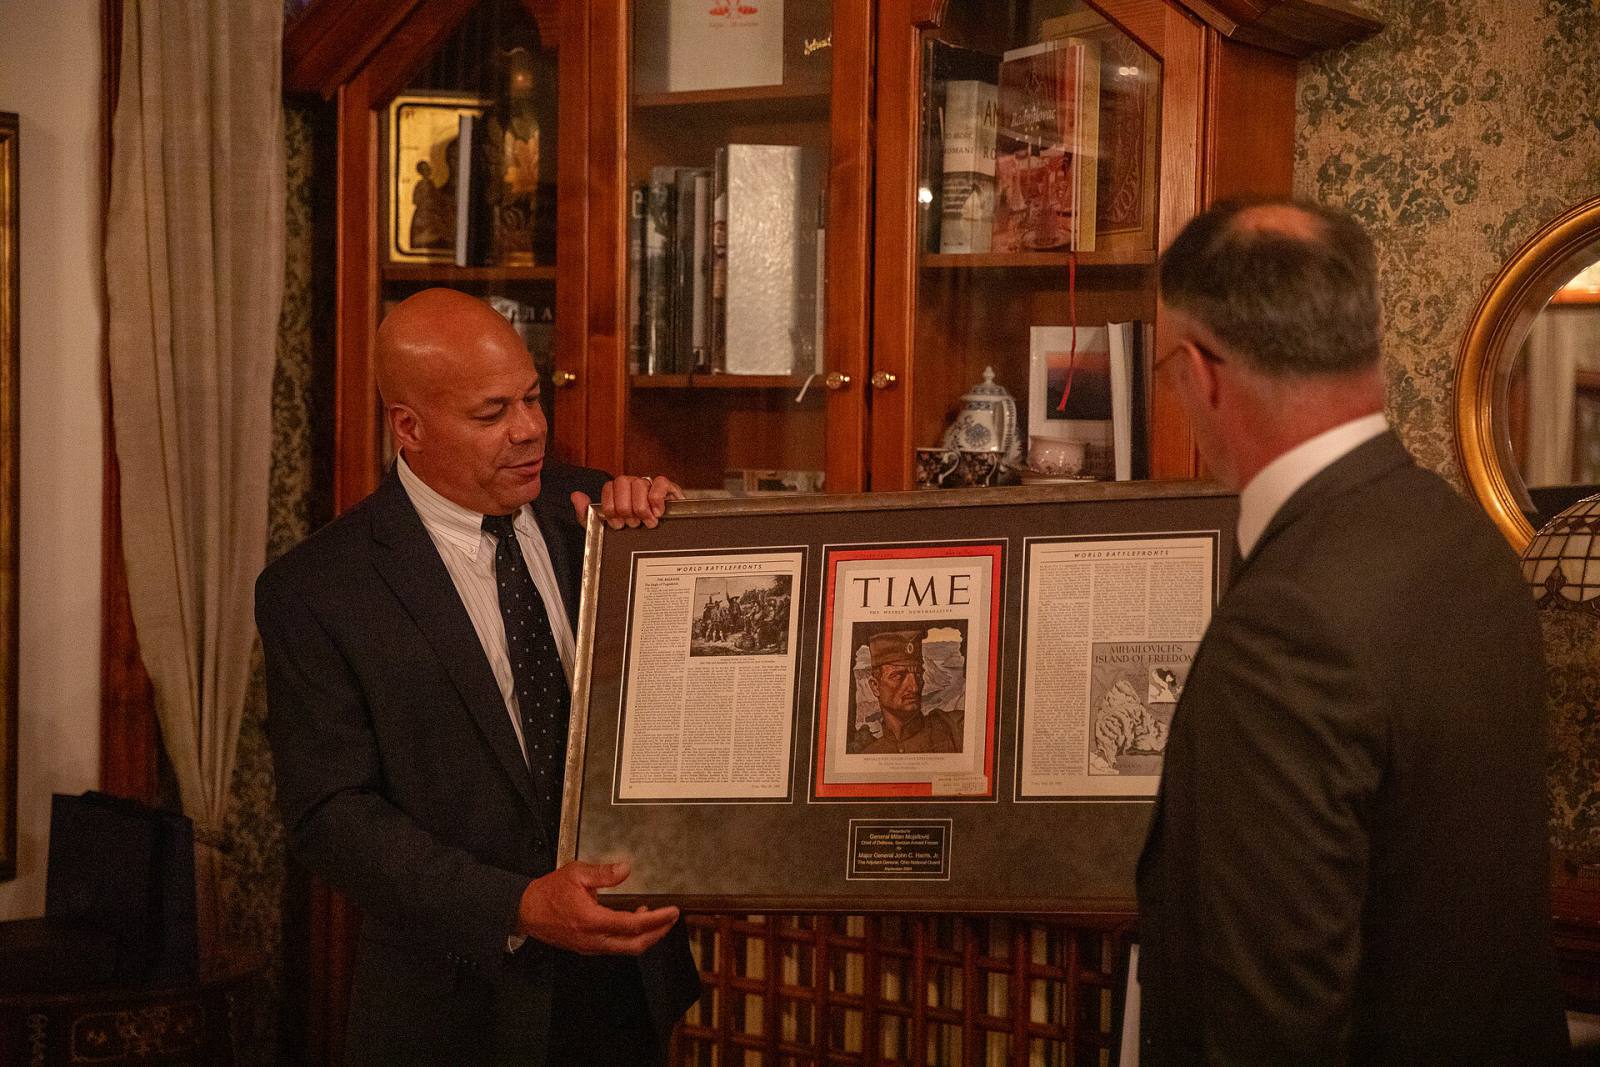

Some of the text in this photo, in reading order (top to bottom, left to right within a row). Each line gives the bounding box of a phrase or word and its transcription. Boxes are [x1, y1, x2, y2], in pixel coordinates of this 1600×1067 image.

[1105, 550, 1169, 558] BATTLEFRONTS
[853, 575, 970, 608] TIME
[1095, 655, 1130, 664] ISLAND
[1131, 655, 1144, 664] OF
